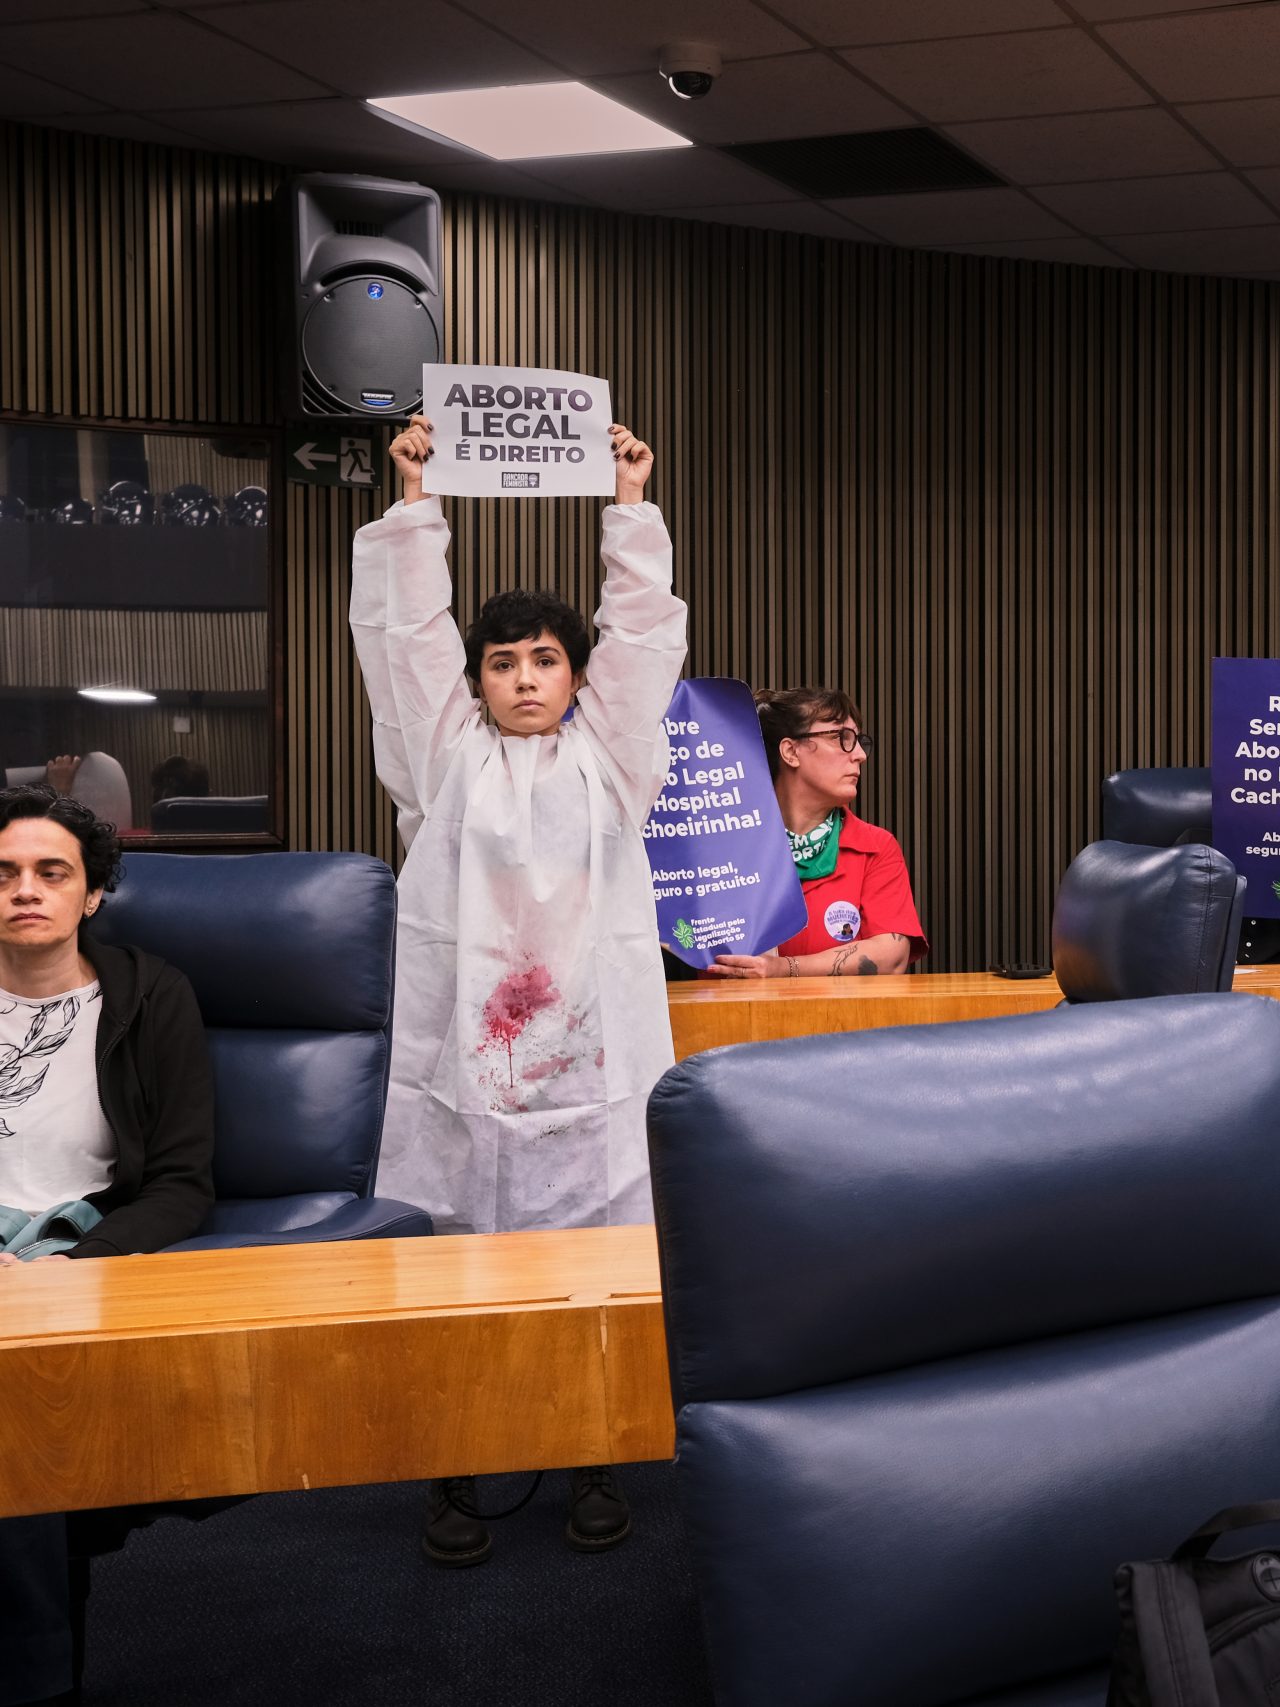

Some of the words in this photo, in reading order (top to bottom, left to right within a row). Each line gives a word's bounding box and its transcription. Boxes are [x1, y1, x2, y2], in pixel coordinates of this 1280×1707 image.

[443, 383, 593, 412] ABORTO
[461, 411, 581, 440] LEGAL
[455, 438, 471, 461] É
[479, 444, 585, 464] DIREITO
[695, 740, 725, 759] de
[682, 761, 745, 787] Legal
[1244, 768, 1272, 781] no
[653, 786, 742, 815] Hospital
[642, 809, 762, 839] choeirinha!
[652, 869, 695, 882] Aborto
[697, 861, 738, 879] legal,
[653, 886, 683, 900] guro
[684, 885, 693, 896] e
[695, 872, 761, 897] gratuito!
[690, 917, 716, 926] Frente
[692, 921, 727, 934] Estadual
[727, 918, 746, 928] pela
[707, 936, 735, 949] Aborto
